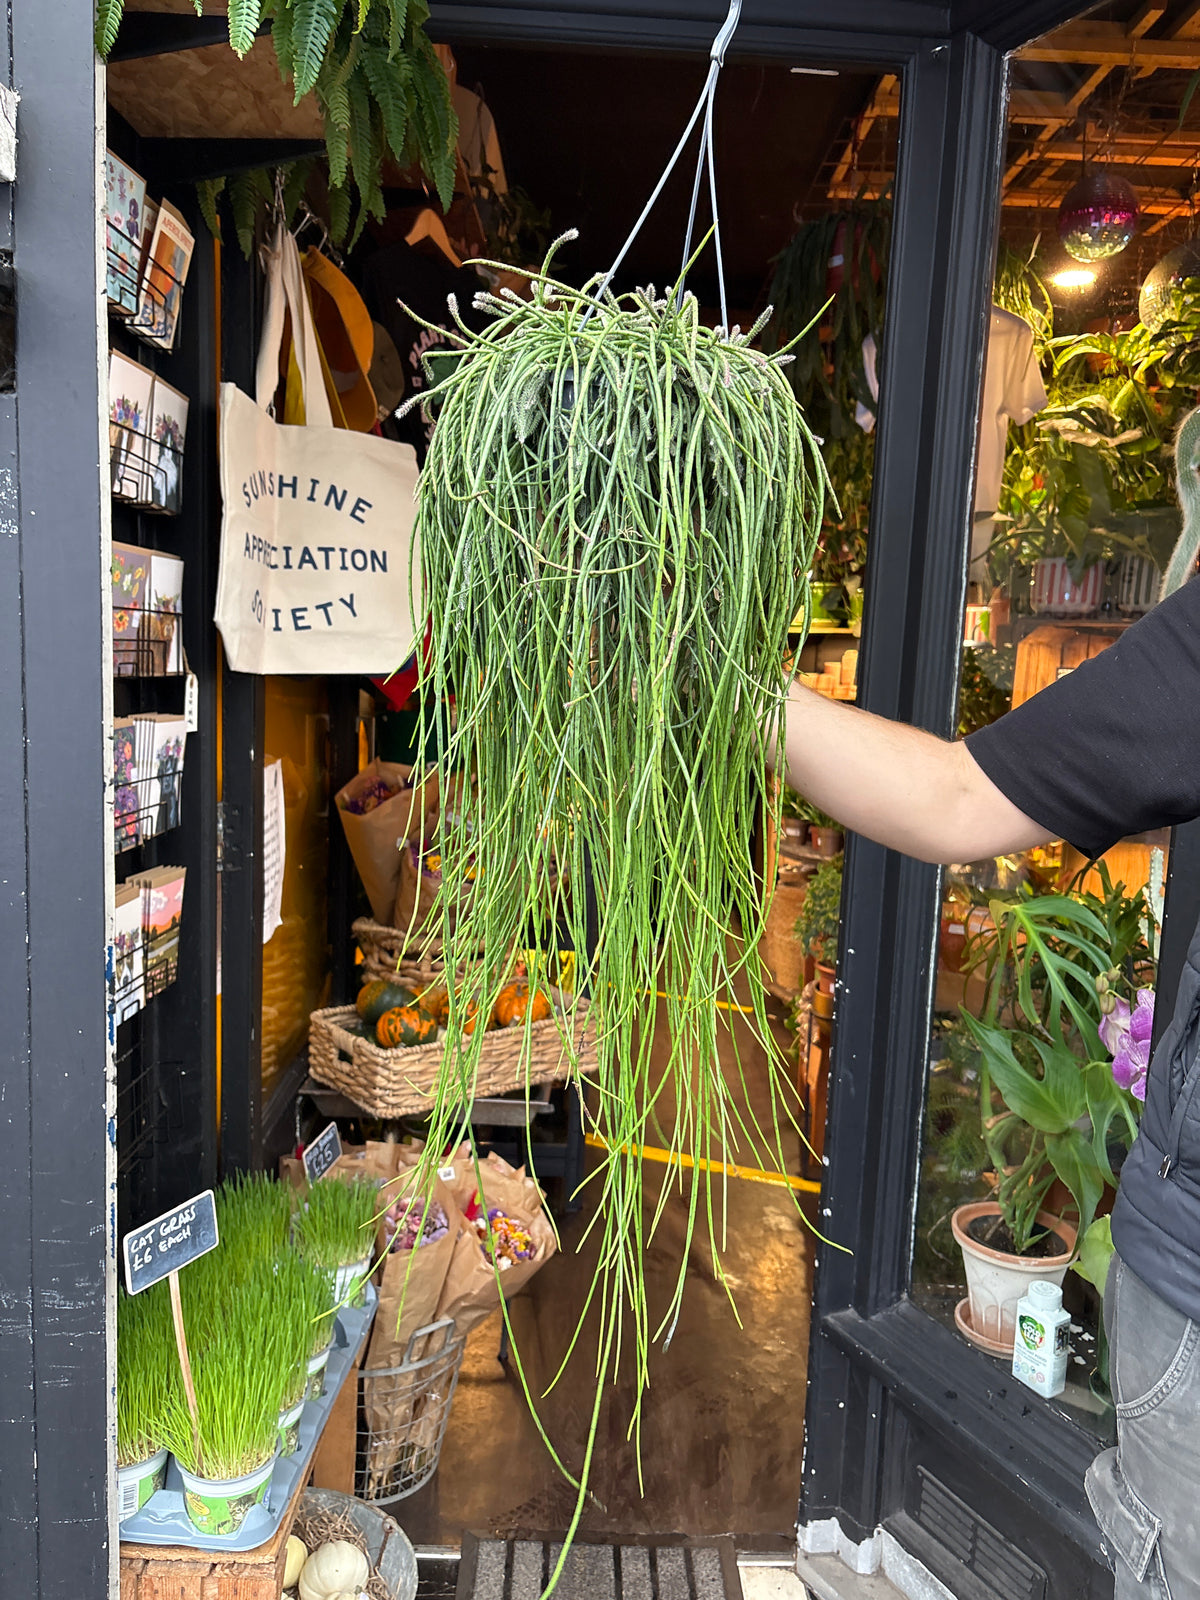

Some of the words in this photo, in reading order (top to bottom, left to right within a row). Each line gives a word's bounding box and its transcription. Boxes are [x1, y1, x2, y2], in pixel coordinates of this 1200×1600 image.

[242, 470, 373, 524] SUNSHINE
[251, 589, 358, 632] SOIETY
[130, 1228, 156, 1254] CAT
[159, 1204, 196, 1237] GRASS
[132, 1246, 153, 1272] £6
[158, 1224, 192, 1252] EACH
[1022, 1322, 1040, 1337] GOLD
